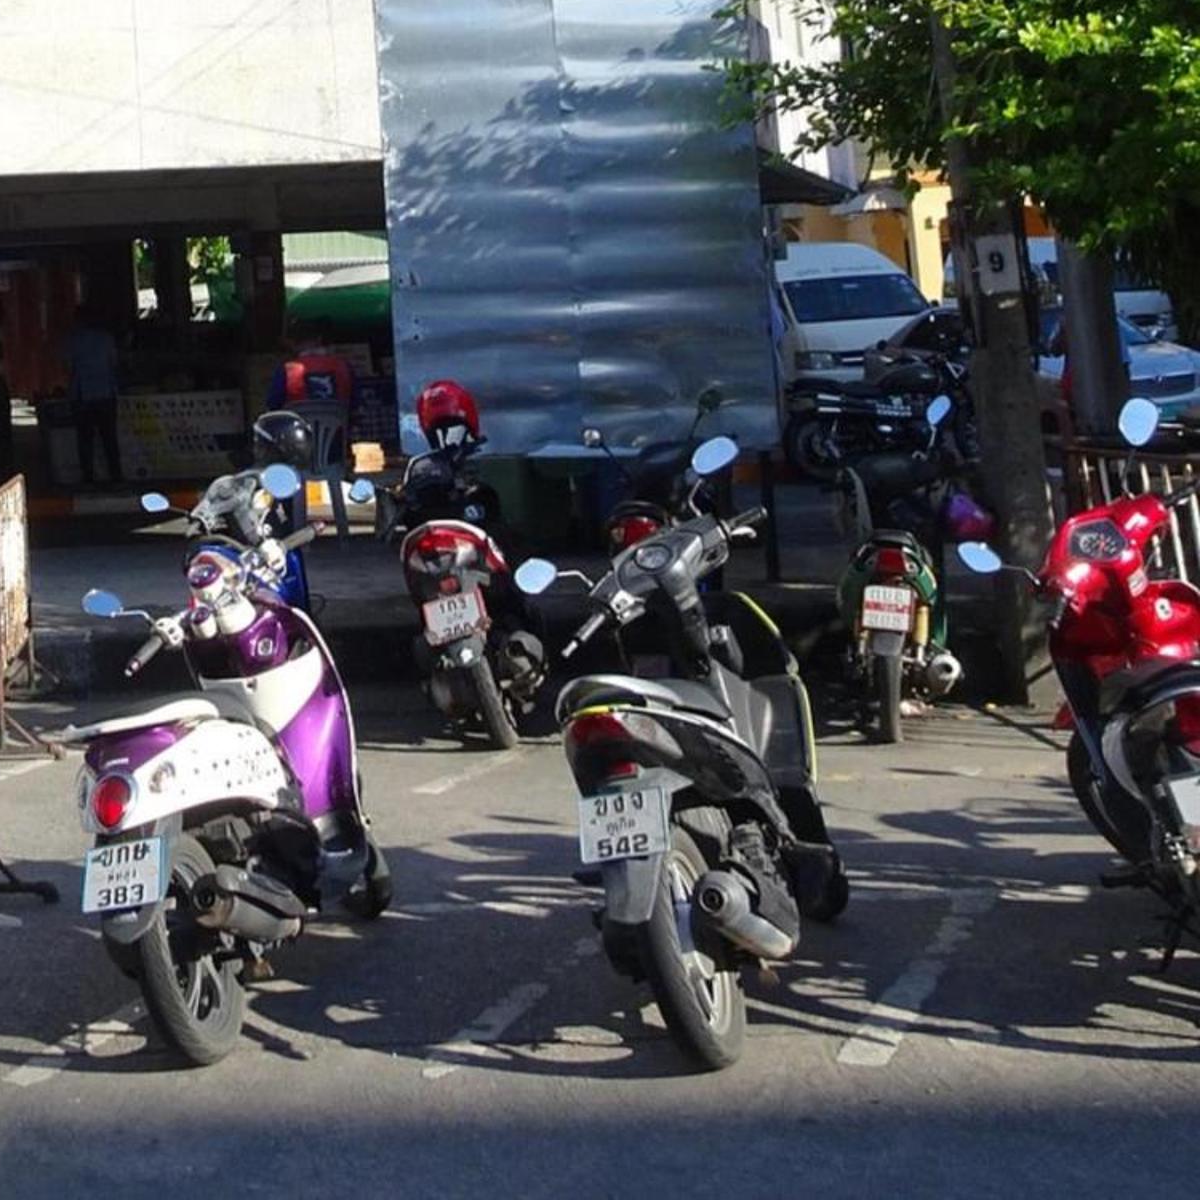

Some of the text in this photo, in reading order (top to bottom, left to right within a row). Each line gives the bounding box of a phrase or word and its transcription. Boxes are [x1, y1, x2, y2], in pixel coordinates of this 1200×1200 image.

[988, 251, 1005, 274] 9
[597, 833, 649, 858] 542
[97, 883, 145, 908] 383
